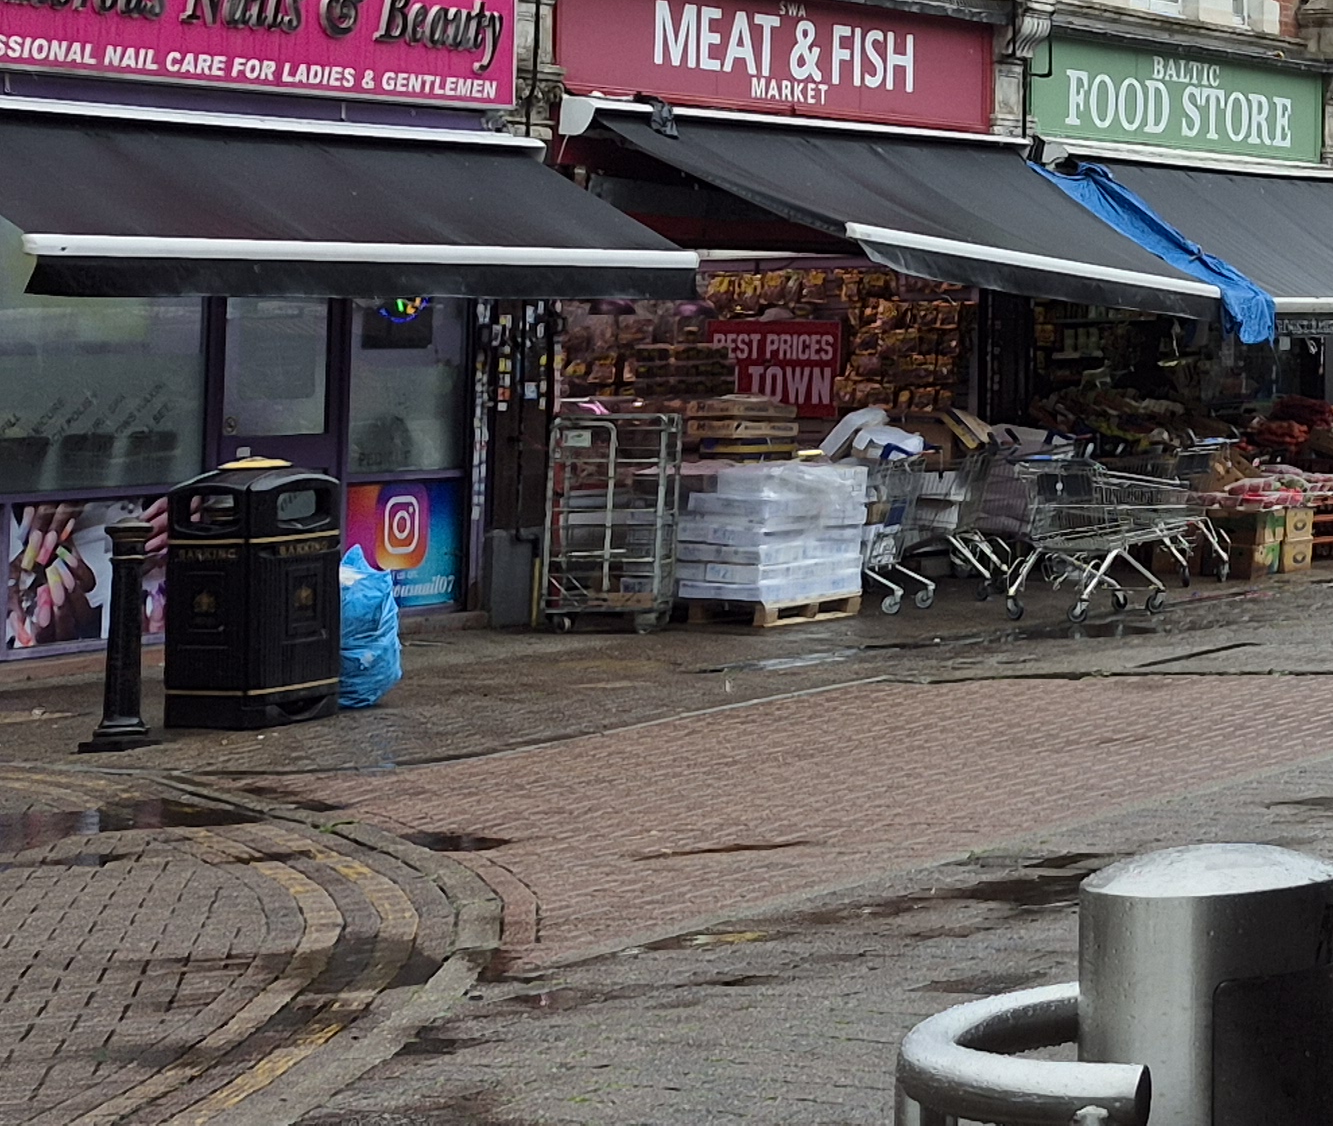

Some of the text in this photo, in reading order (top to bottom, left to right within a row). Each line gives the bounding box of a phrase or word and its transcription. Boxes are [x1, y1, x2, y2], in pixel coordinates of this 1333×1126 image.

[778, 0, 807, 18] SWA
[653, 0, 915, 93] MEAT & FISH
[104, 45, 159, 72] NAIL
[165, 50, 226, 77] CARE
[232, 56, 276, 82] FOR
[281, 62, 356, 89] LADIES
[361, 69, 376, 90] &
[381, 71, 498, 100] GENTLEMEN
[1152, 55, 1220, 87] BALTIC
[750, 76, 829, 106] MARKET
[1065, 69, 1292, 148] FOOD STORE
[766, 333, 834, 360] PRICES
[748, 365, 832, 405] TOWN
